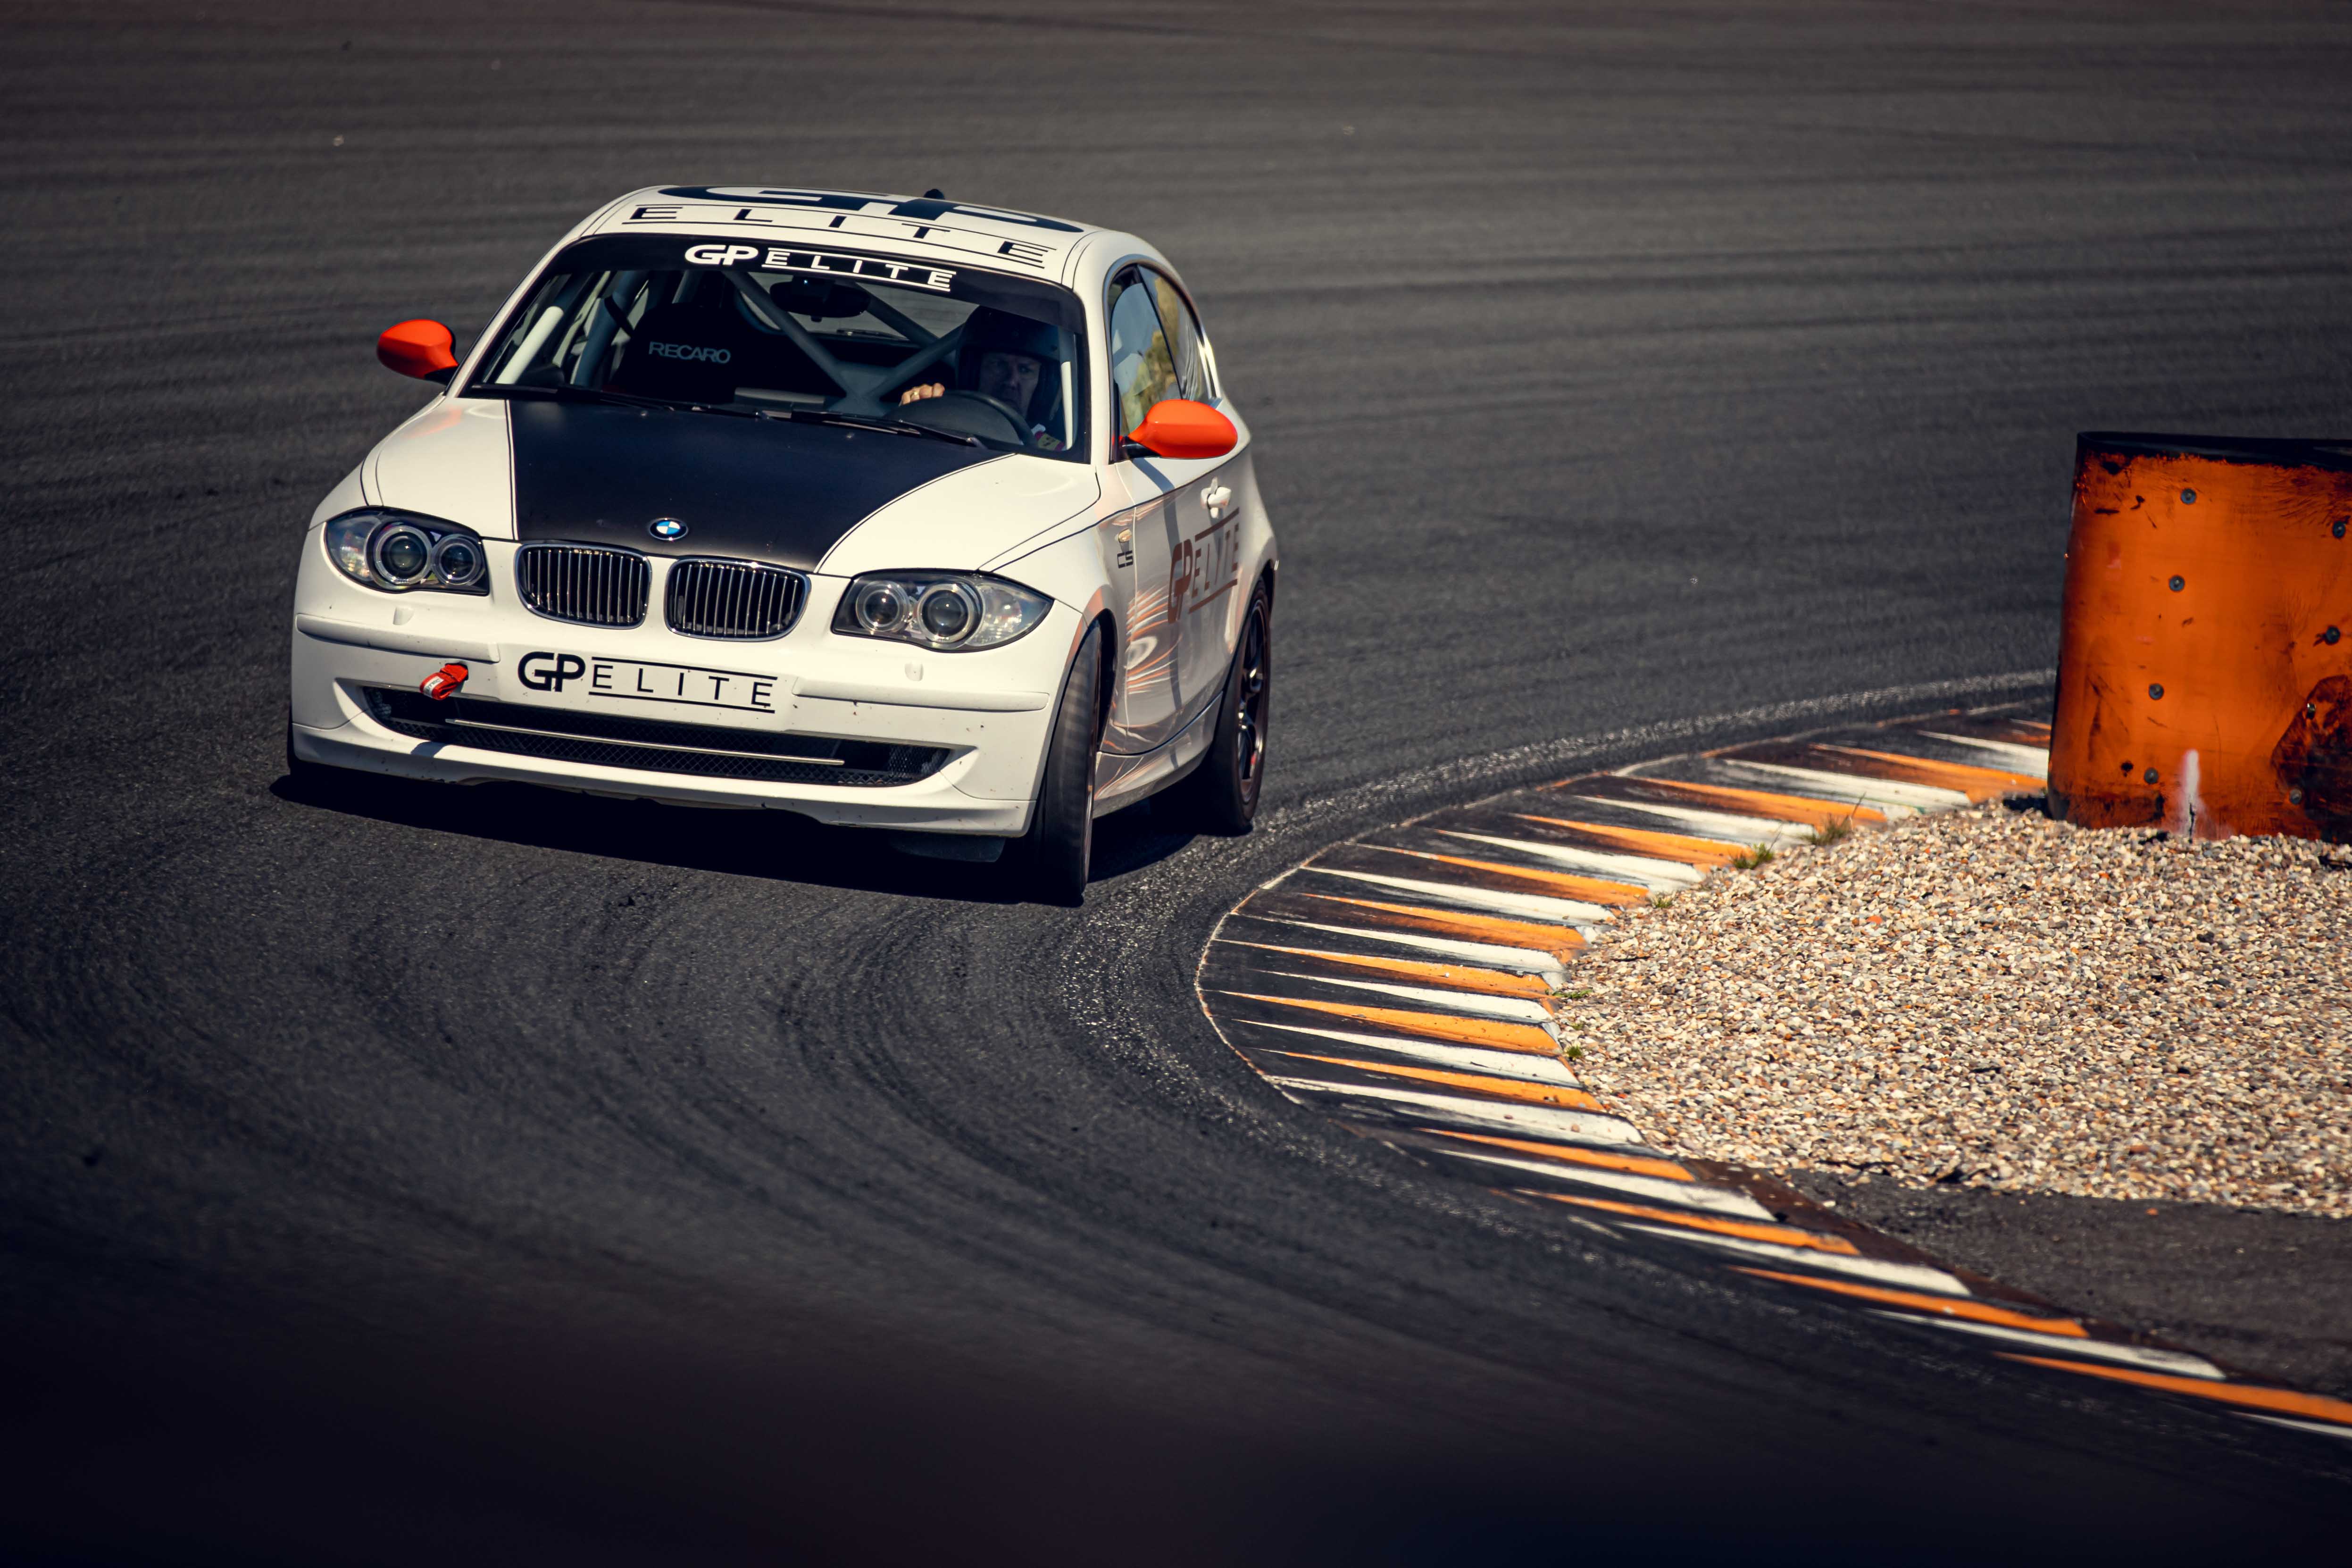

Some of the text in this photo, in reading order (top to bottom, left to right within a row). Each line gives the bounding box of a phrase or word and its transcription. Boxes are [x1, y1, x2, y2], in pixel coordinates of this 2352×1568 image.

[630, 207, 1048, 263] ELITE
[765, 250, 953, 288] ELITE
[649, 341, 731, 364] RECARO
[518, 651, 773, 707] GP ELITE
